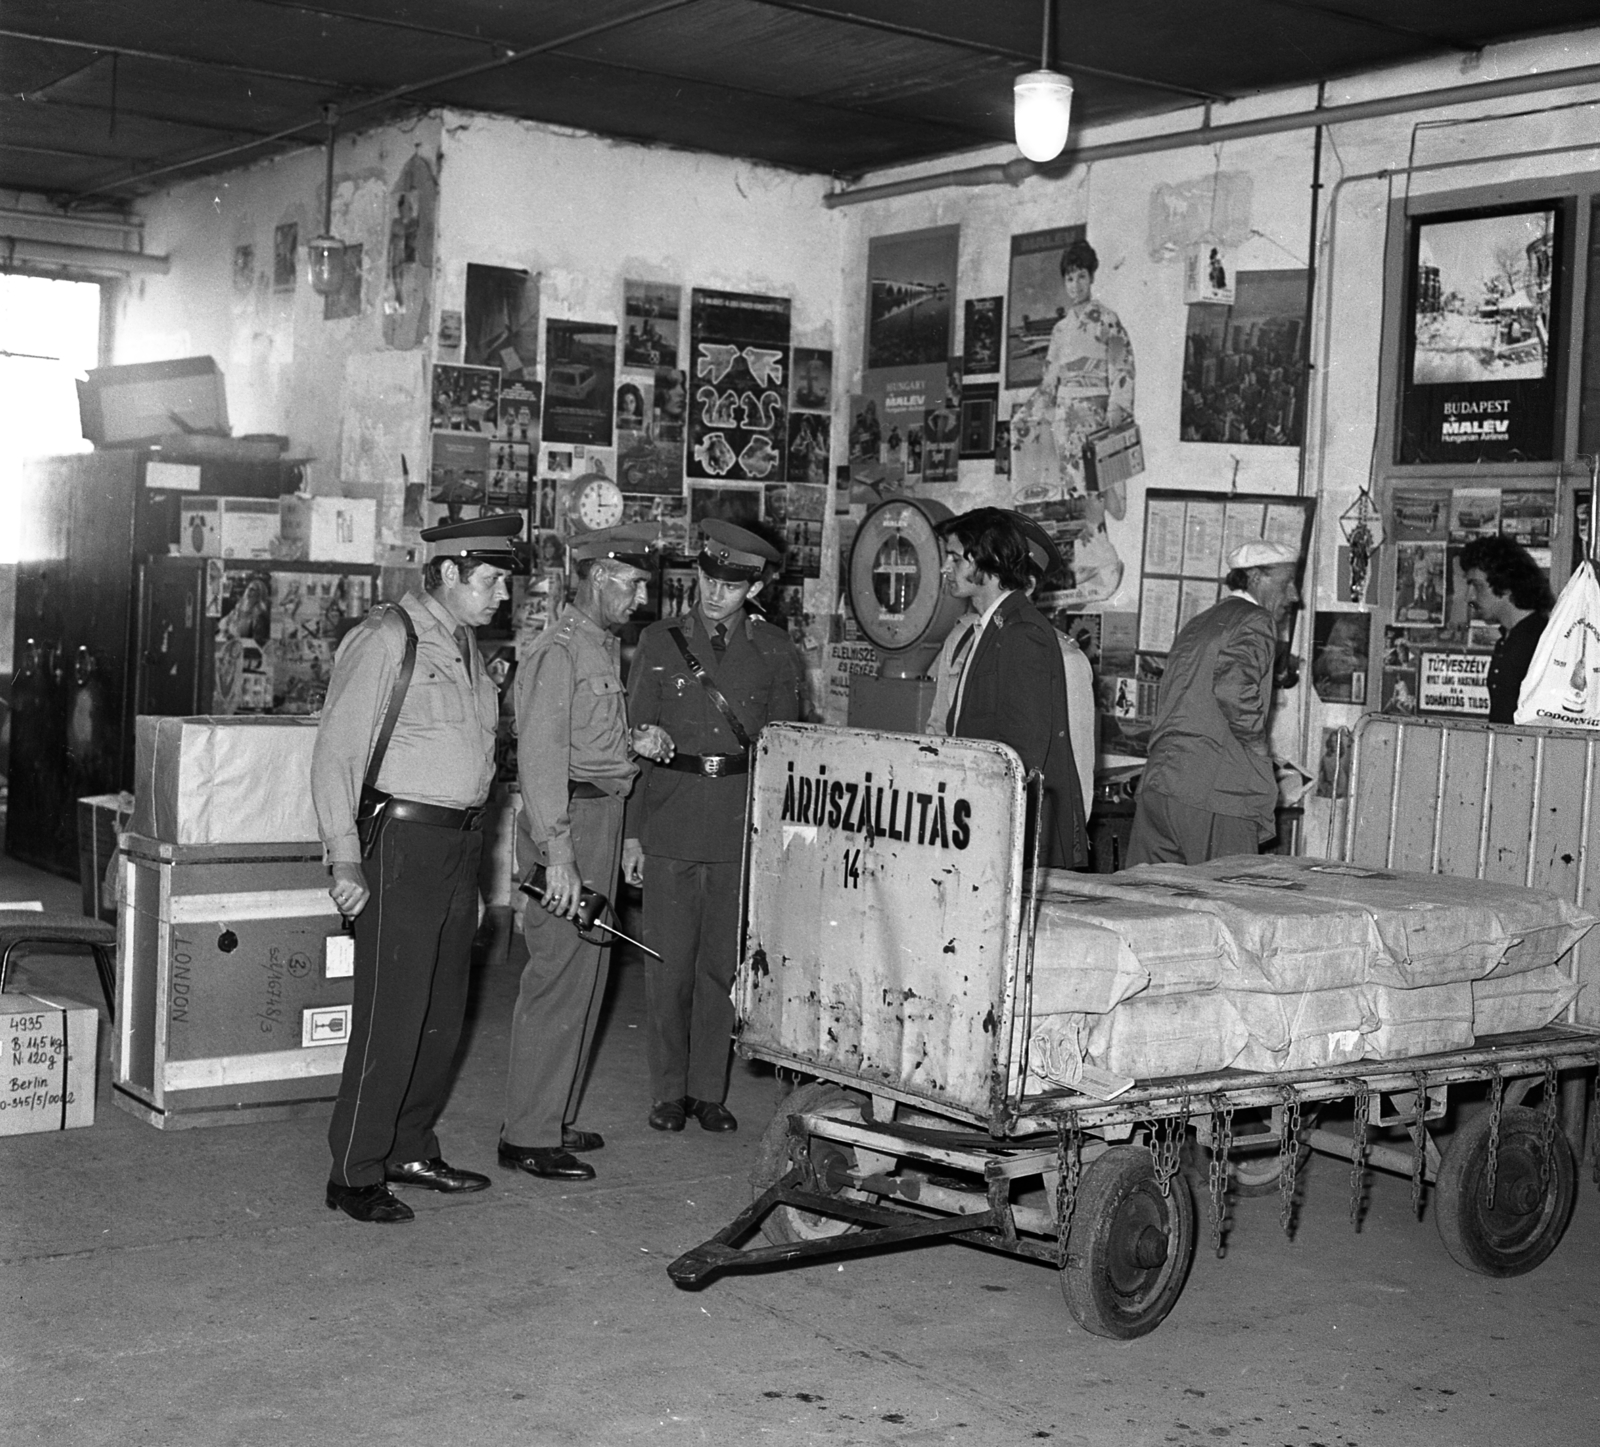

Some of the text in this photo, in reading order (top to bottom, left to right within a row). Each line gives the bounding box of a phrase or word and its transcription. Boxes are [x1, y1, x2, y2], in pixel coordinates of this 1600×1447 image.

[1443, 400, 1511, 415] BUDAPEST
[843, 848, 861, 889] 14
[172, 938, 192, 1024] LONDON
[10, 1014, 45, 1032] 4935
[9, 1076, 48, 1092] Berlin
